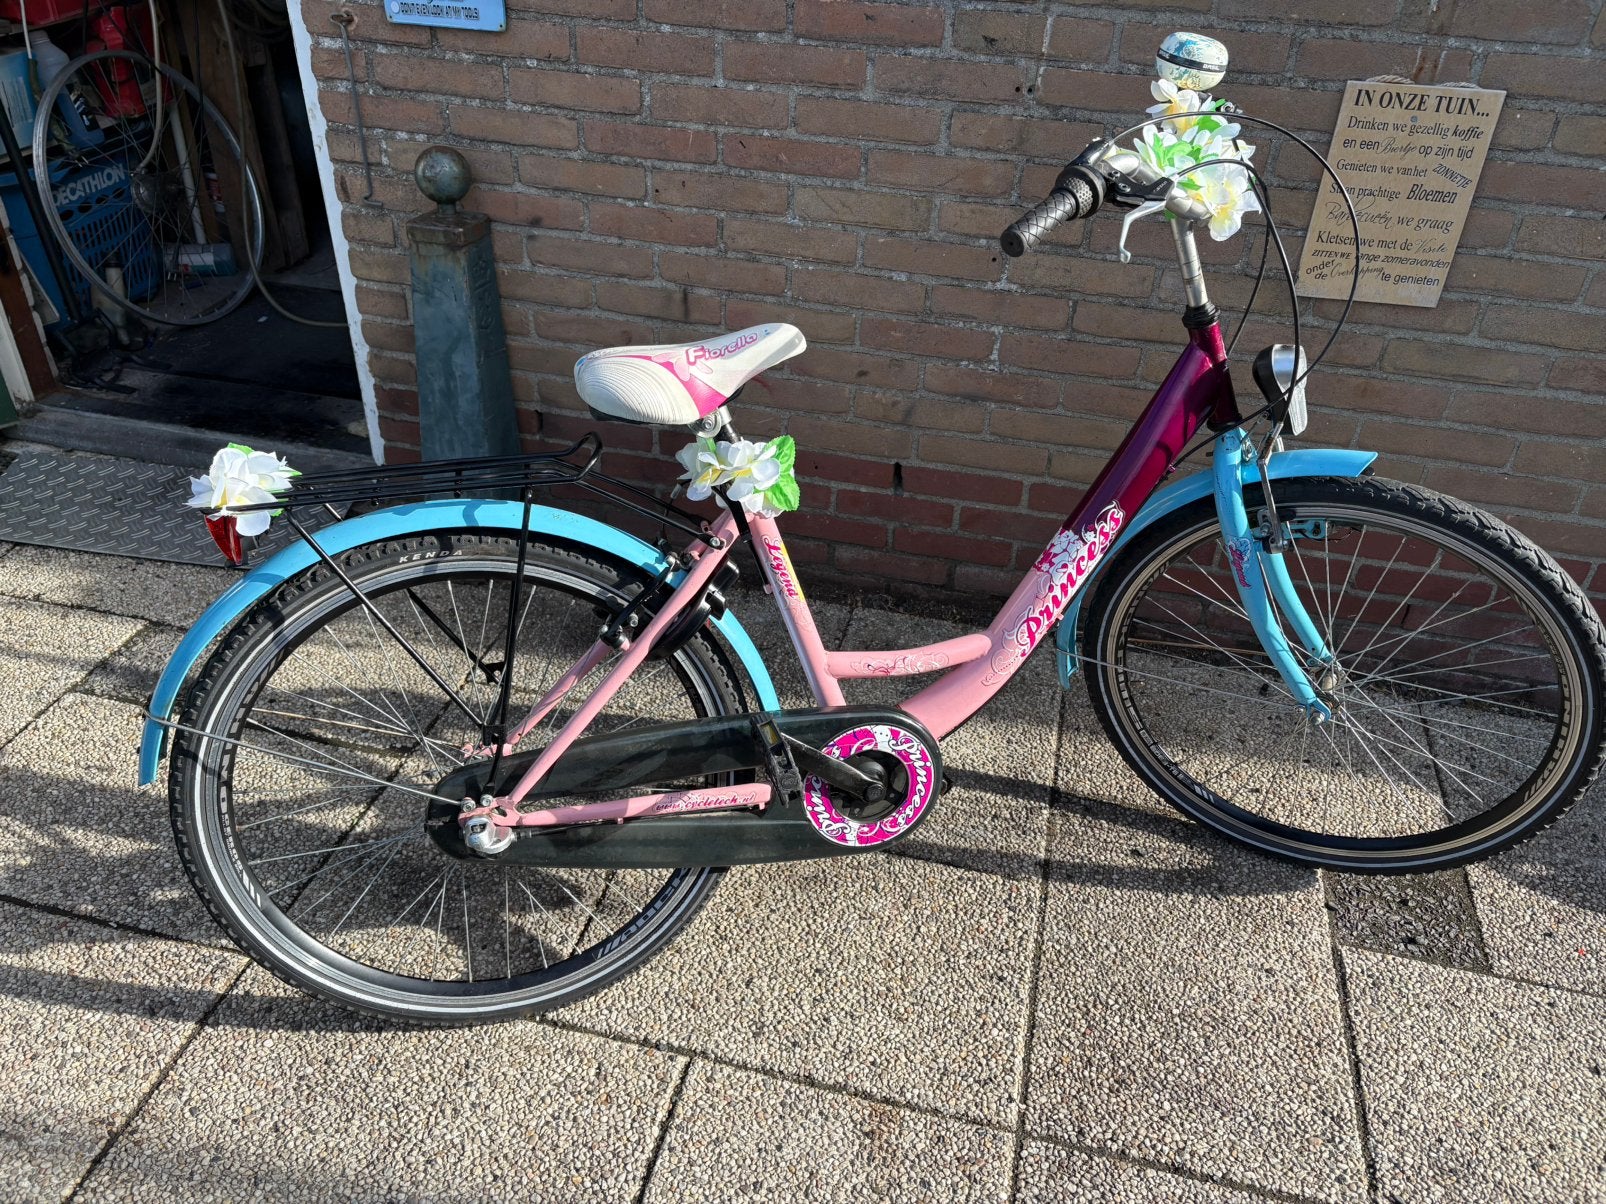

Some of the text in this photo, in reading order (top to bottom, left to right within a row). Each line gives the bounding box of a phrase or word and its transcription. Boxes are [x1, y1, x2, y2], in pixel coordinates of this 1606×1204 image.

[1354, 89, 1490, 117] IN ONZE TUIN...
[1347, 115, 1484, 141] Drinken we gezellig koffie
[1342, 138, 1357, 149] en
[1359, 140, 1380, 151] een
[1418, 145, 1433, 157] op
[1435, 144, 1454, 159] zijn
[1457, 146, 1475, 162] tijd
[53, 163, 125, 206] DECATHLON
[1336, 159, 1378, 173] Genieten
[1380, 164, 1394, 174] we
[1432, 163, 1472, 188] ZONNETJE
[1357, 185, 1400, 200] prachtige
[1406, 183, 1458, 204] Bloemen
[1397, 215, 1414, 227] we
[1414, 217, 1454, 235] graag
[1316, 231, 1355, 246] Kletsen
[1360, 237, 1375, 248] we
[1376, 239, 1398, 250] met
[1399, 238, 1414, 252] de
[1306, 259, 1336, 275] onder
[1311, 249, 1339, 259] ZITTEN
[1339, 252, 1352, 260] WE
[1381, 254, 1451, 269] zomeravonden
[1314, 271, 1328, 280] de
[1381, 272, 1391, 282] te
[1392, 274, 1440, 287] genieten
[685, 331, 758, 367] Fiorella
[399, 550, 462, 563] KENDA
[761, 535, 799, 599] Legend
[1015, 503, 1125, 658] Princess
[887, 732, 934, 828] Princess
